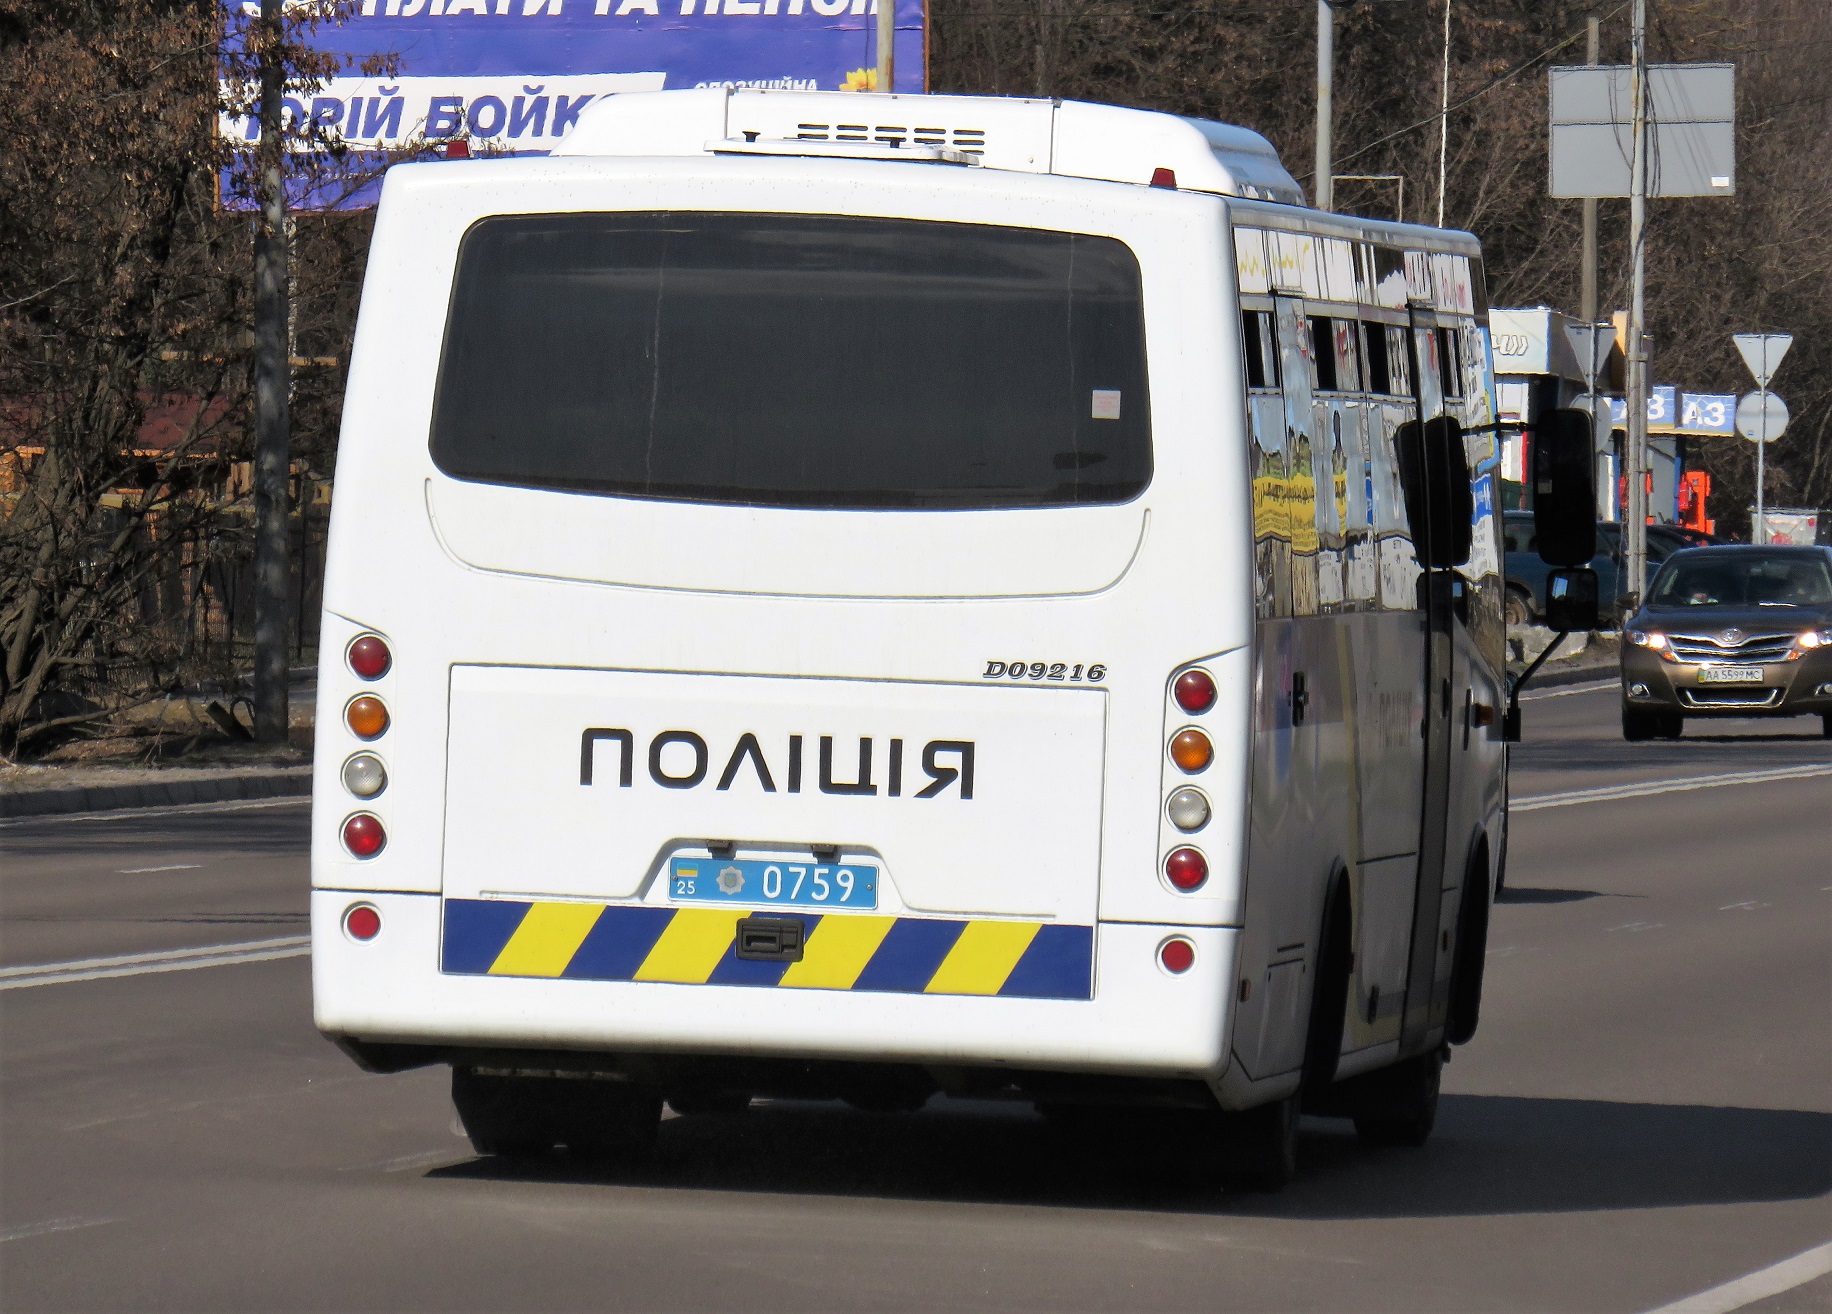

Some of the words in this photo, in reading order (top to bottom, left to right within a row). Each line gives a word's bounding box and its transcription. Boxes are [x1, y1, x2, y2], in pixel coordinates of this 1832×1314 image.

[424, 84, 616, 139] БОЙК
[579, 726, 975, 800] ПОЛІЦІЯ
[676, 880, 696, 895] 25
[762, 865, 855, 902] 0759
